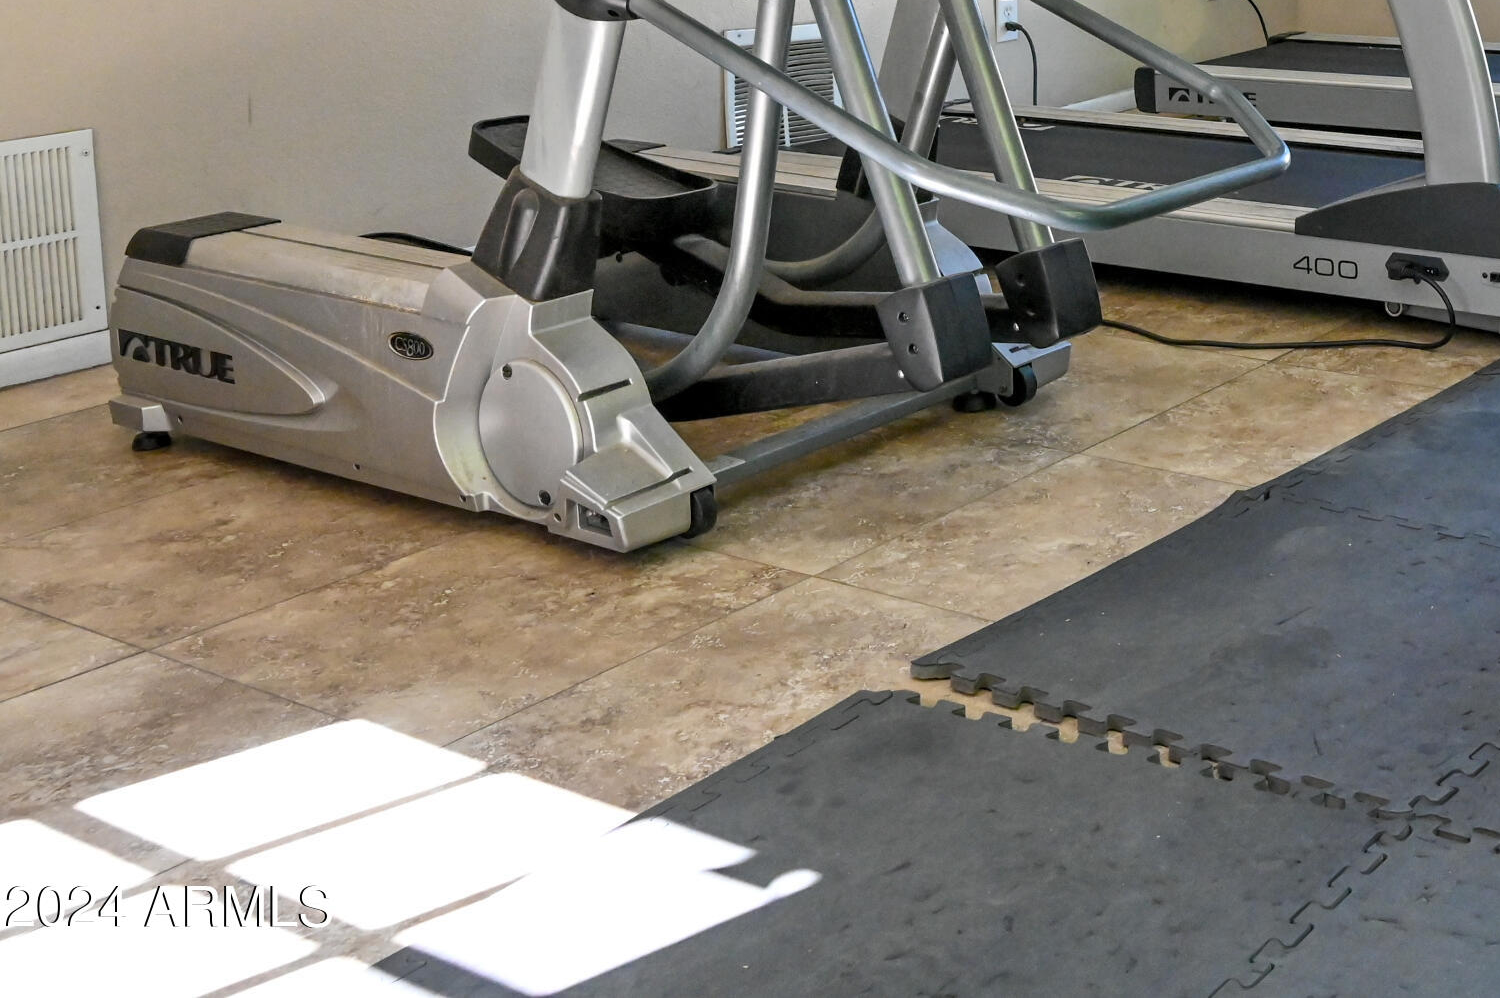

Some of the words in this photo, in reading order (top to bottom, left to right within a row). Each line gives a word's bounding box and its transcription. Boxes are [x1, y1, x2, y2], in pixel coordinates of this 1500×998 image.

[1293, 255, 1358, 279] 400
[395, 336, 425, 357] CS800
[149, 337, 236, 385] TRUE
